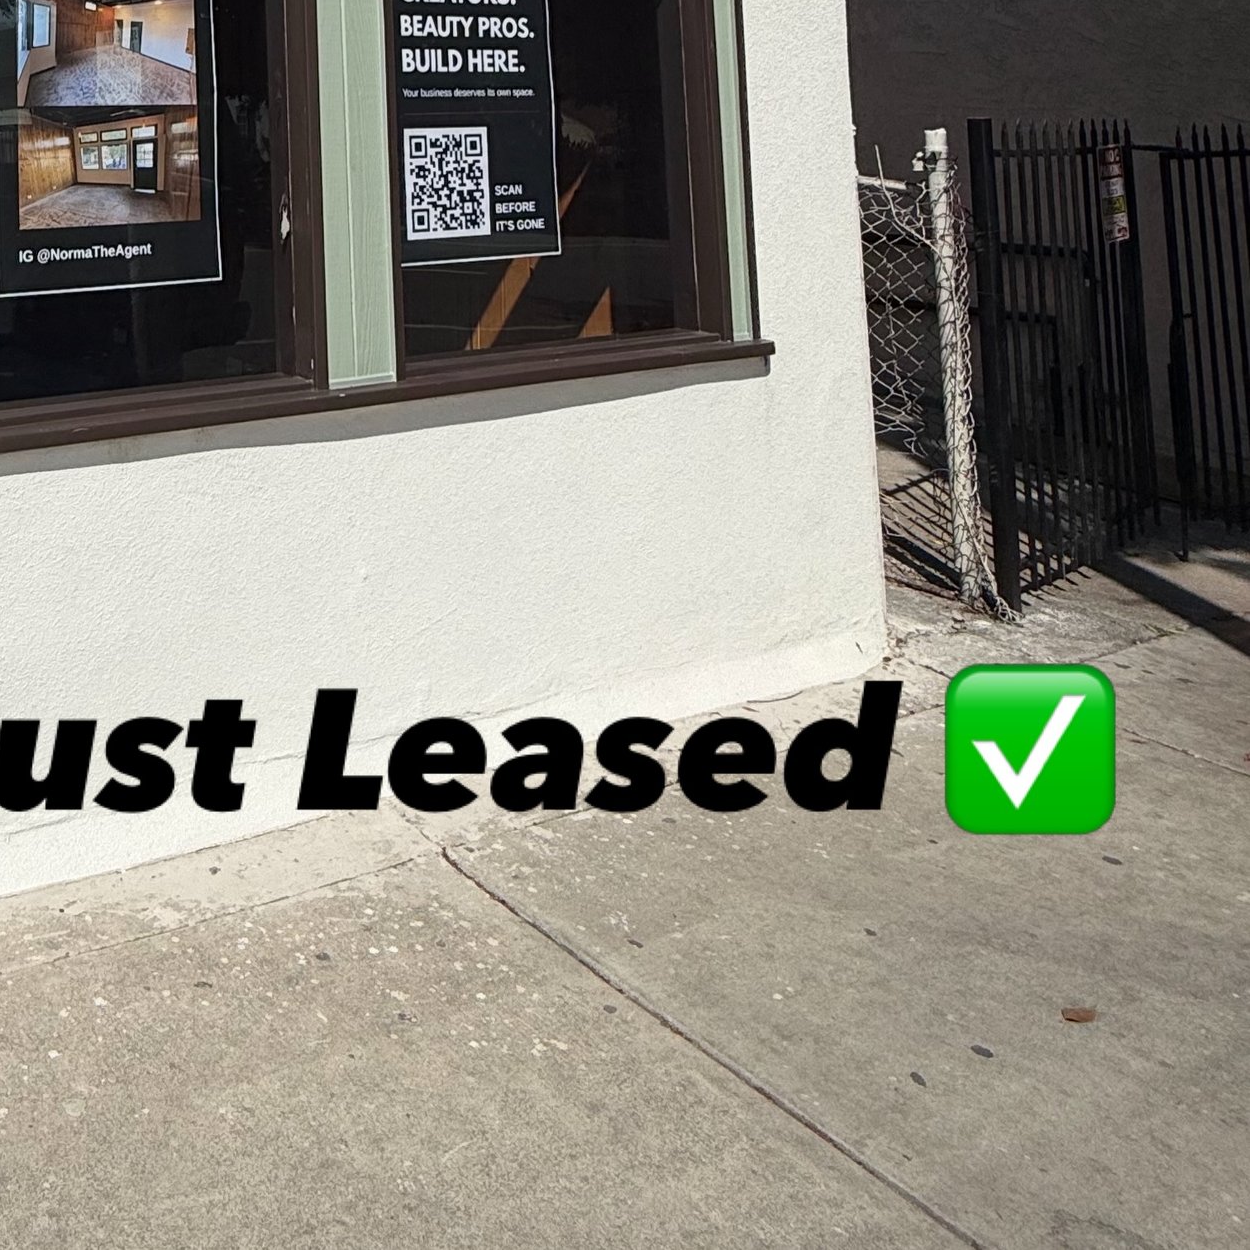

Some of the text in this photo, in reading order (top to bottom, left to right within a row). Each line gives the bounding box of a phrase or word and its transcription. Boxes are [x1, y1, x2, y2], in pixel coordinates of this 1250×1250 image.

[400, 15, 535, 39] BEAUTY PROS.
[402, 49, 525, 73] BUILD HERE.
[402, 88, 419, 97] Your
[420, 87, 452, 97] business
[454, 87, 486, 97] deserves
[487, 87, 495, 97] its
[496, 89, 511, 97] own
[495, 185, 522, 196] SCAN
[495, 201, 536, 214] BEFORE
[496, 218, 545, 232] IT'S GONE
[19, 242, 152, 263] IG @NormaTheAgent
